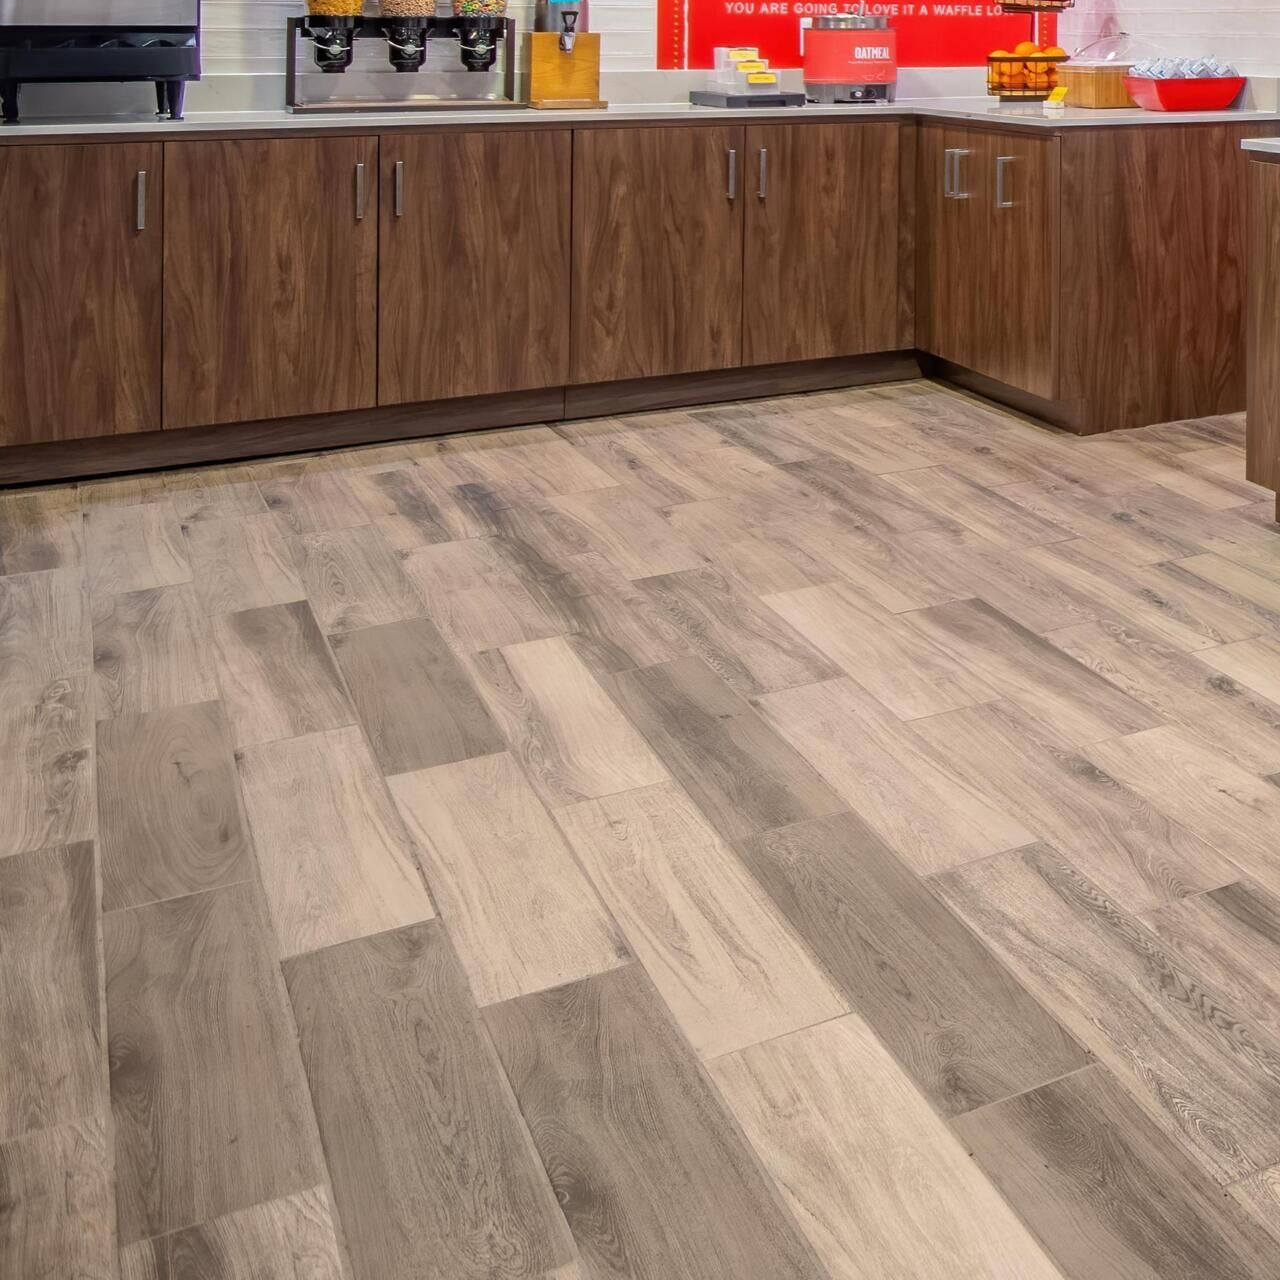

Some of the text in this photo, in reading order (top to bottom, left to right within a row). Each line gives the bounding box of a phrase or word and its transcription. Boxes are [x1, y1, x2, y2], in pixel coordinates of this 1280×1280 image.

[725, 2, 754, 14] YOU
[760, 2, 788, 14] ARE
[793, 2, 838, 15] GOING
[865, 4, 898, 15] LOVE
[903, 4, 914, 15] IT
[918, 5, 928, 16] A
[933, 5, 982, 16] WAFFLE
[854, 47, 890, 60] OATMEAL
